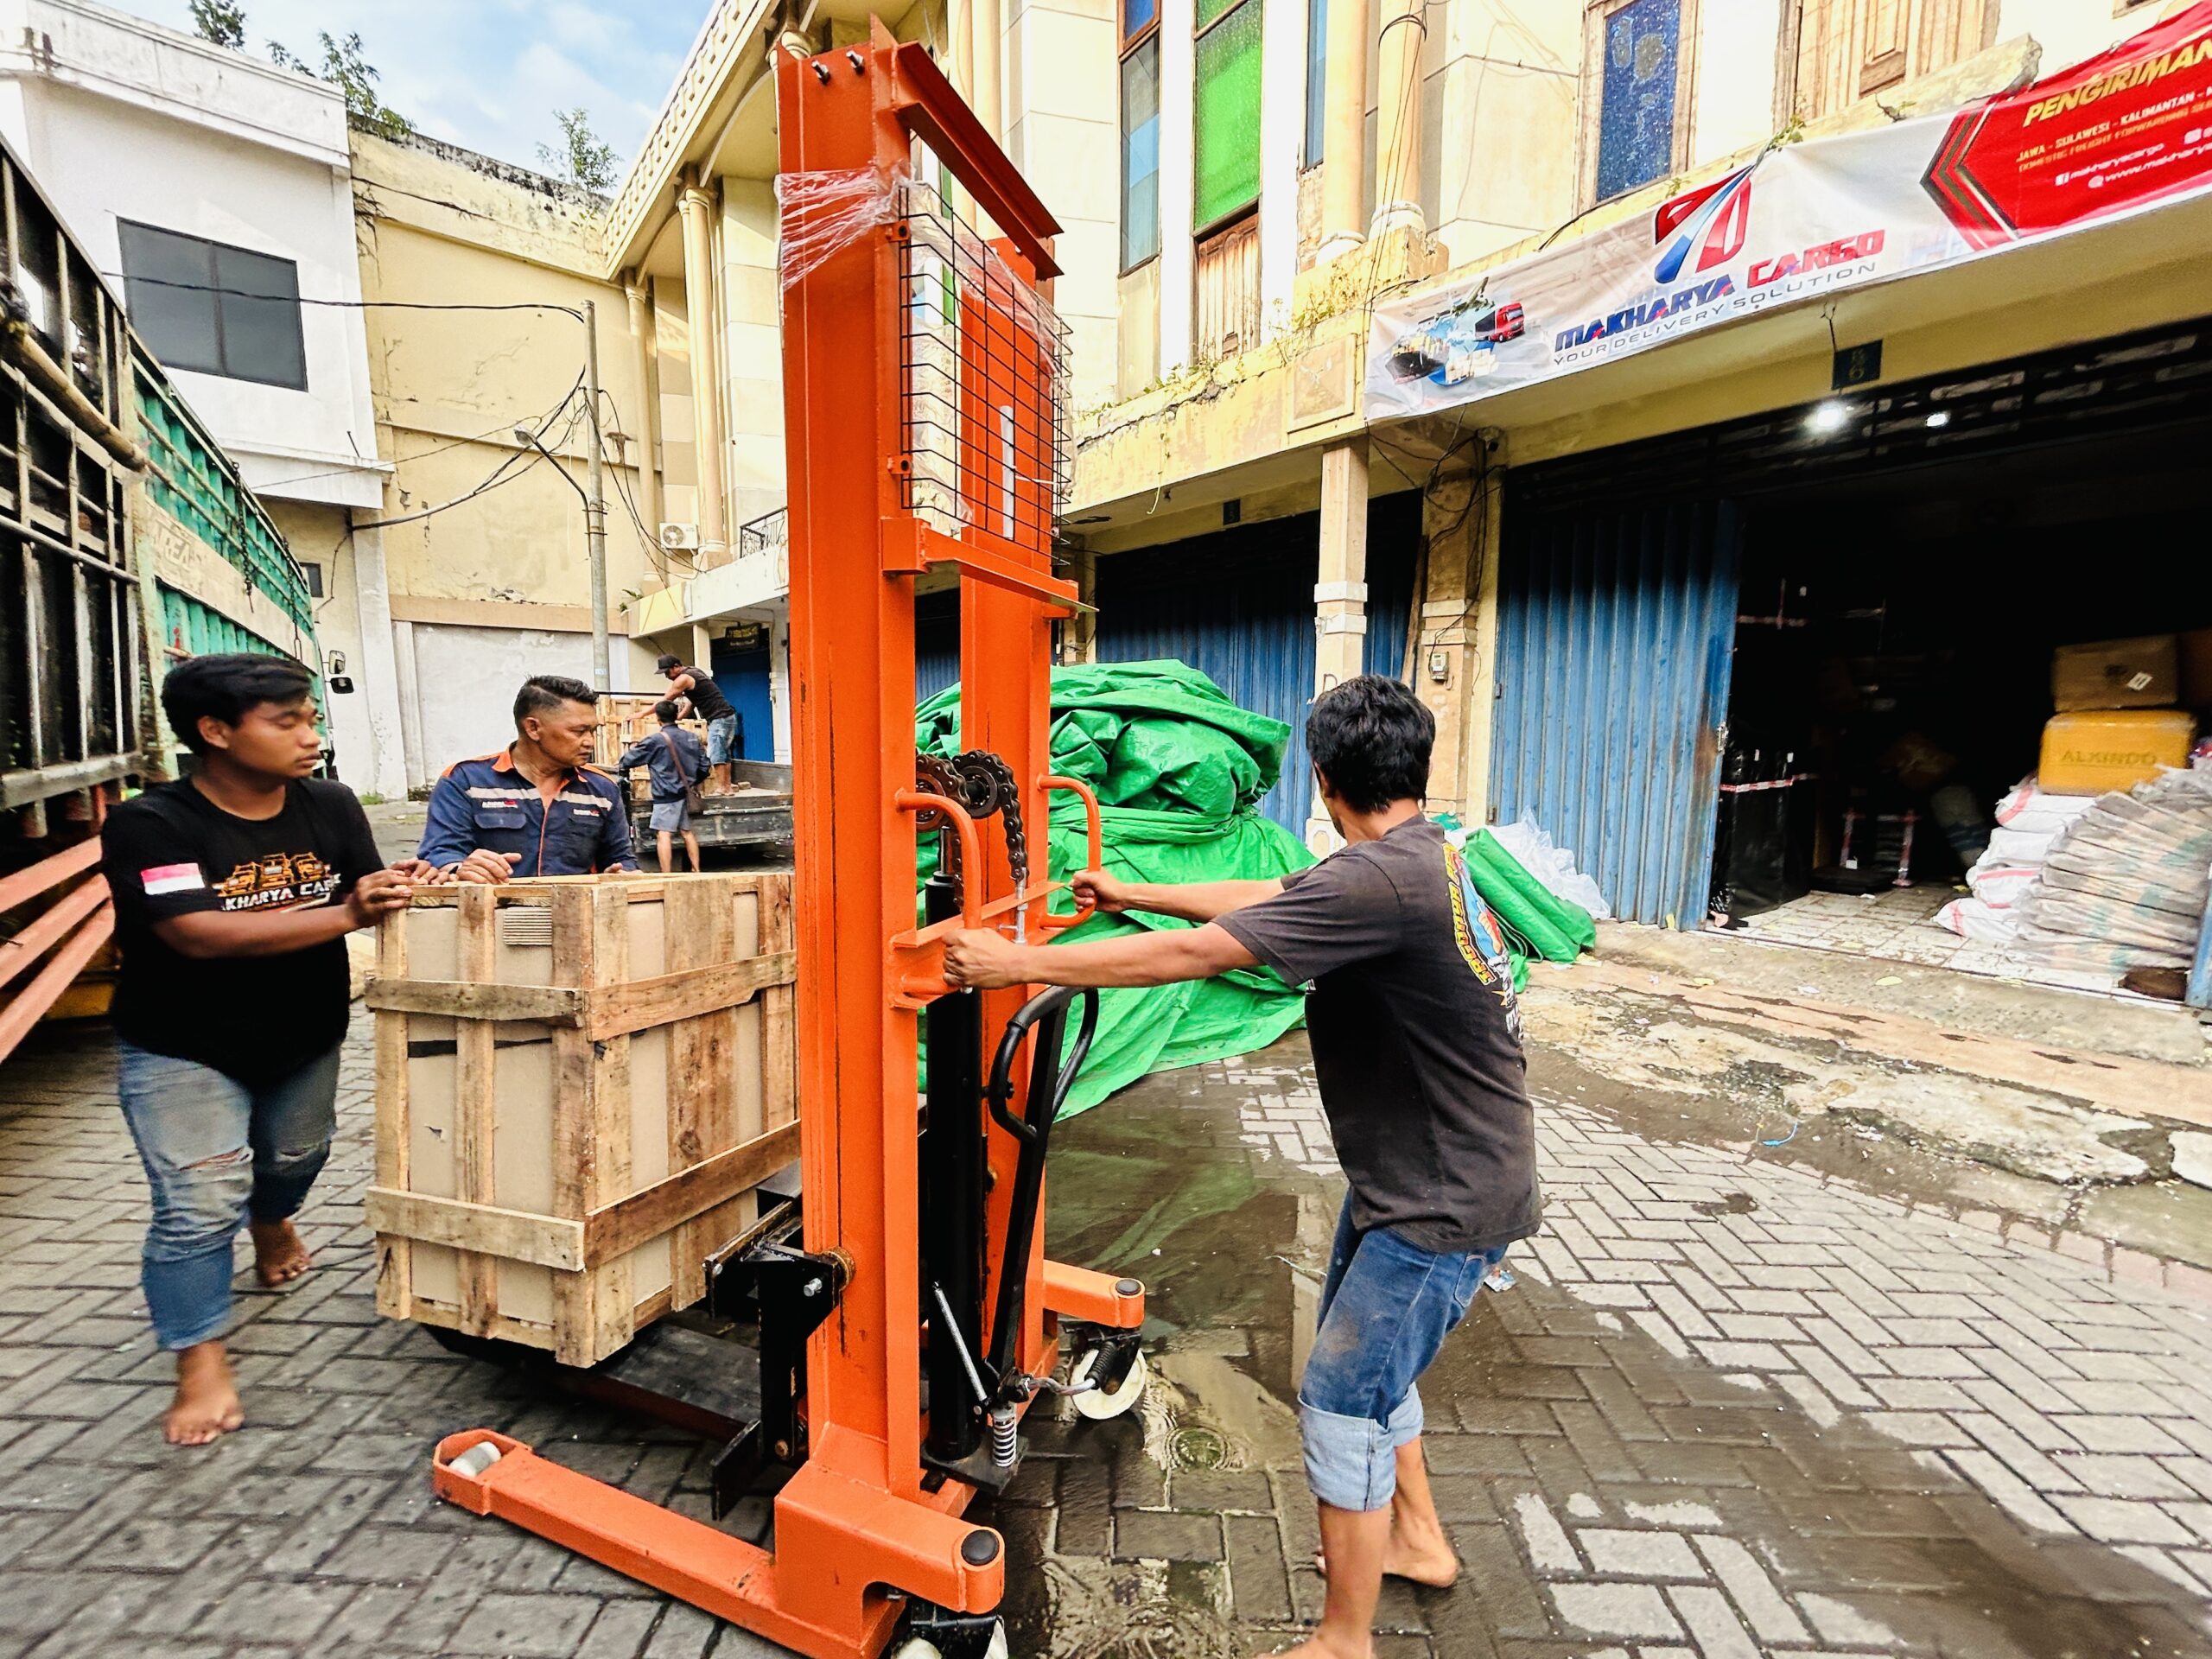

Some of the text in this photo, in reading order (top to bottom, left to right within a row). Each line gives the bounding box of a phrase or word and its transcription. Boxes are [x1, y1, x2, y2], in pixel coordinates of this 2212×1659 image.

[2016, 144, 2045, 162] JAWA
[2056, 121, 2110, 149] SULAWESI
[2120, 92, 2196, 125] KALIMANTAN
[1554, 230, 1885, 353] MAKHARYA CARGO
[1554, 262, 1875, 365] YOUR DELIVERY SOLUTION
